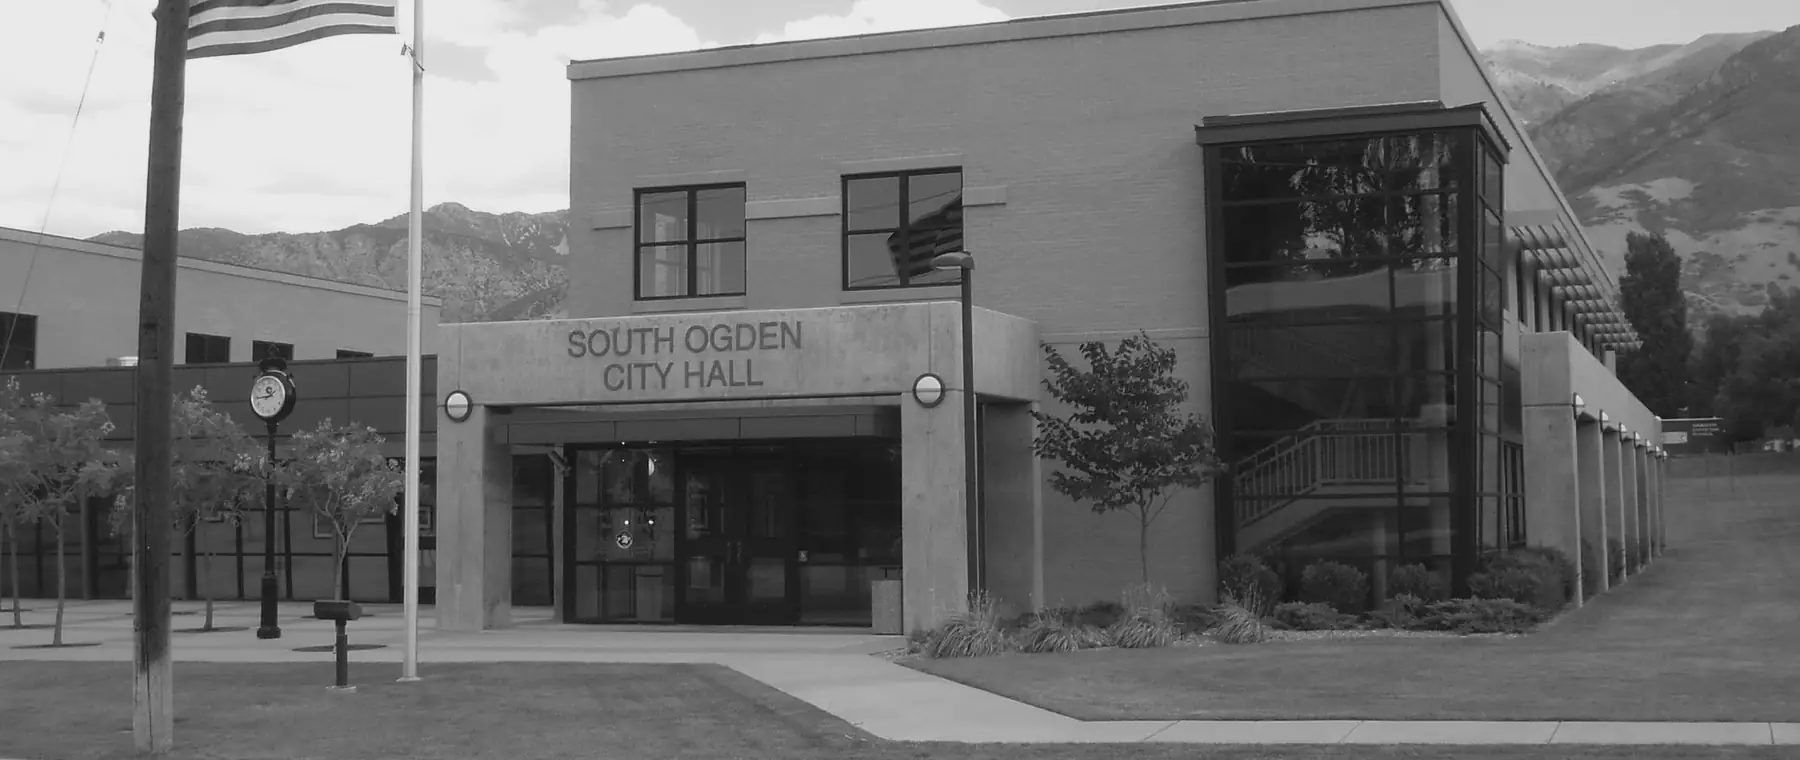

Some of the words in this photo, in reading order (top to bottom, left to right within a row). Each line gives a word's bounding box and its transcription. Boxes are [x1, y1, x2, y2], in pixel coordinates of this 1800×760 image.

[568, 327, 674, 357] SOUTH
[684, 321, 801, 353] OGDEN
[603, 361, 674, 391] CITY
[684, 358, 764, 389] HALL
